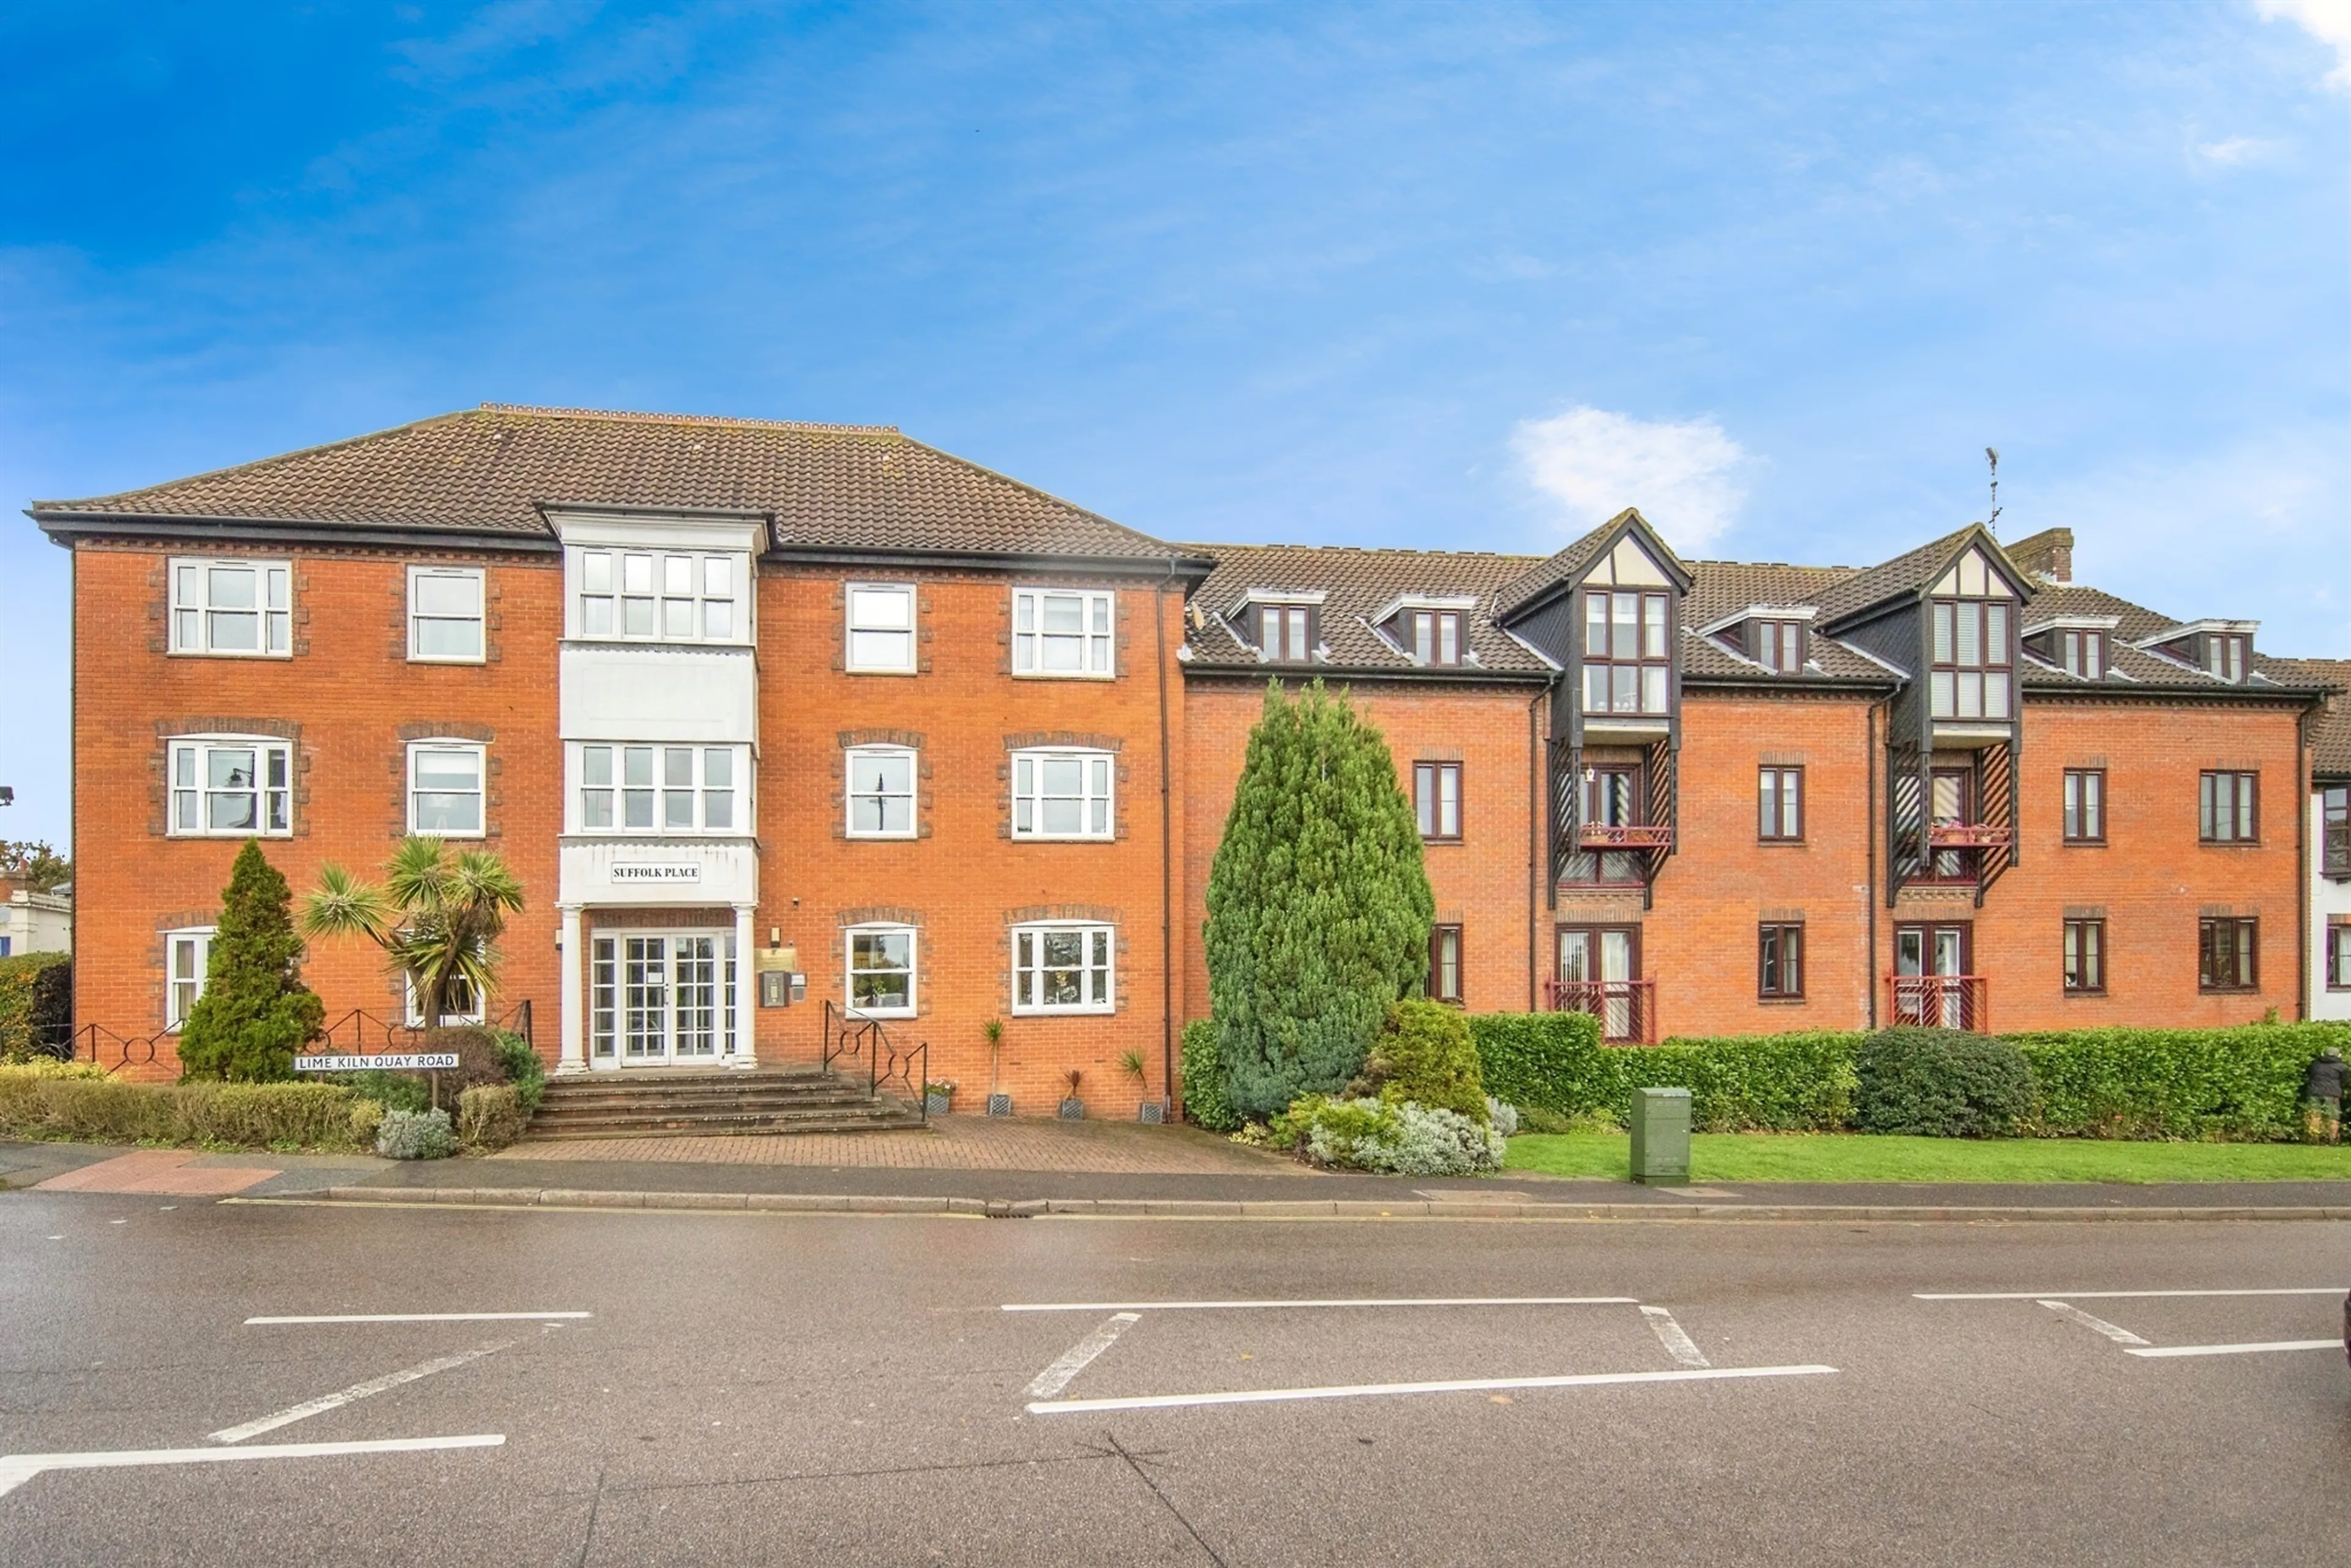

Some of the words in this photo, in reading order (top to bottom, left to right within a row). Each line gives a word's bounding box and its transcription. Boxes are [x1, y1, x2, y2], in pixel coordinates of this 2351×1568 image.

[613, 868, 662, 877] SUFFOLK
[665, 868, 698, 877] PLACE
[299, 1058, 331, 1068] LIME
[338, 1057, 369, 1067] KILN
[374, 1056, 411, 1067] QUAY
[418, 1056, 454, 1066] ROAD
